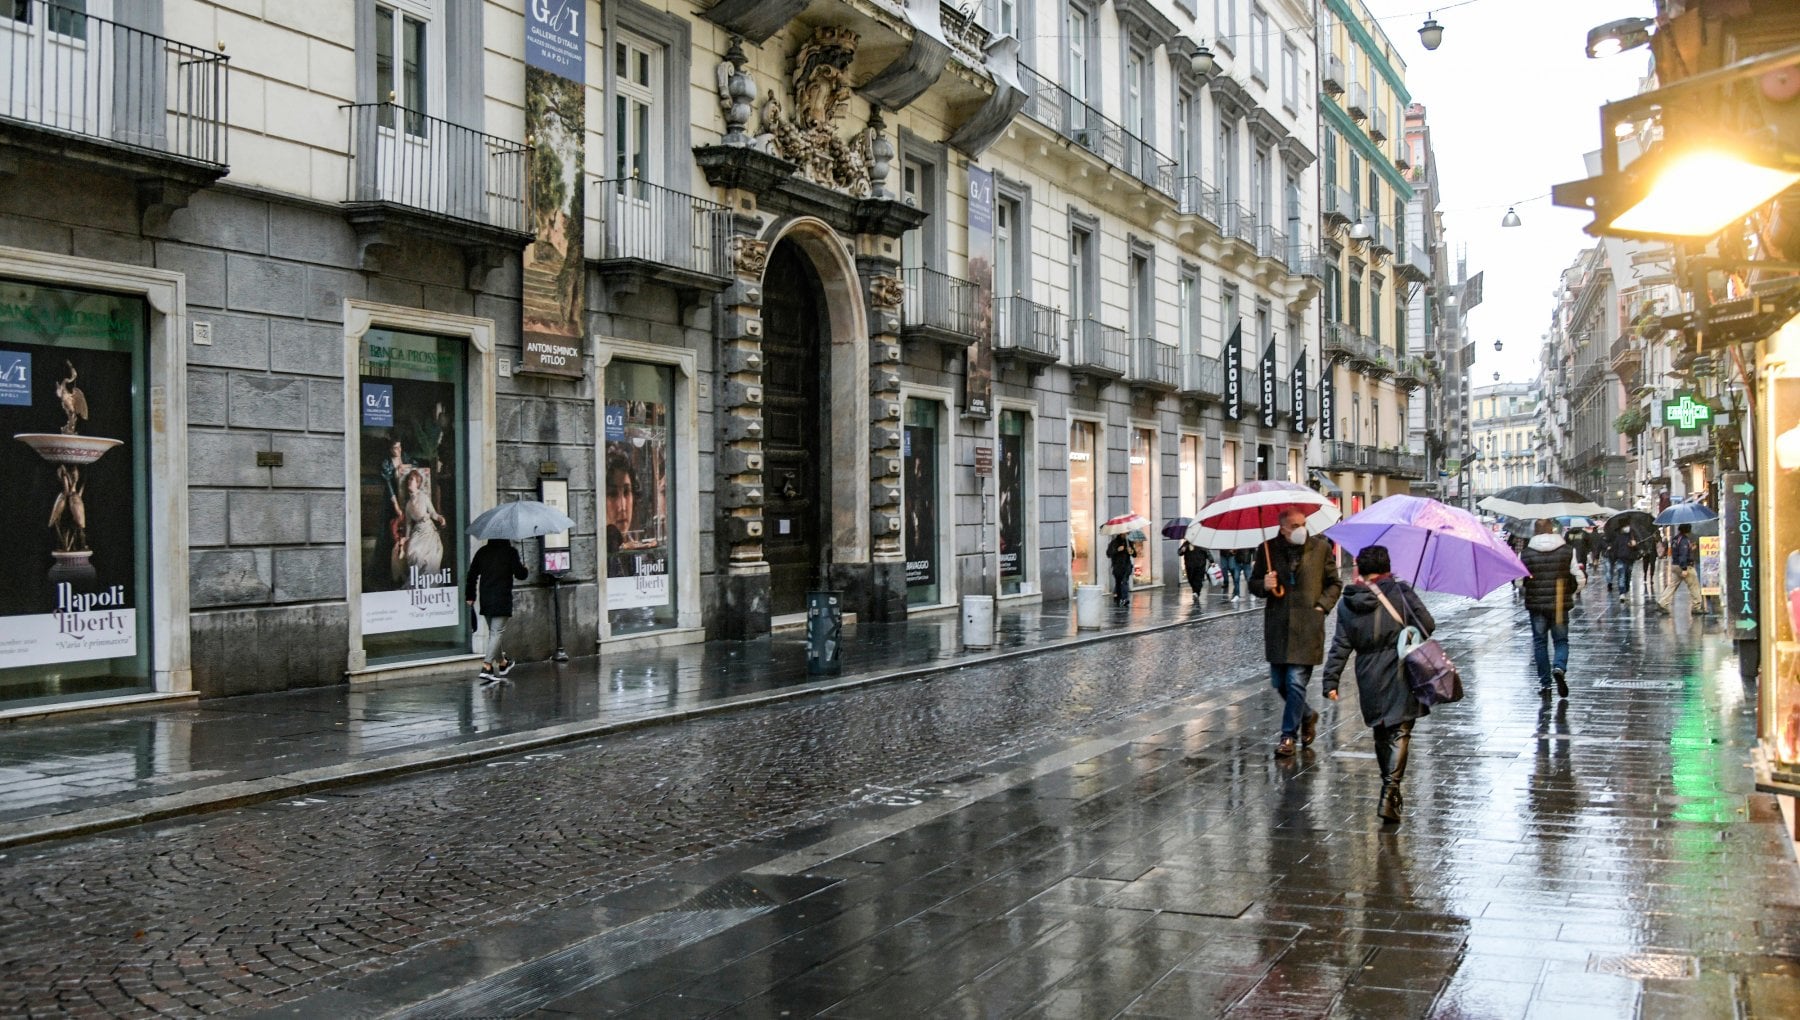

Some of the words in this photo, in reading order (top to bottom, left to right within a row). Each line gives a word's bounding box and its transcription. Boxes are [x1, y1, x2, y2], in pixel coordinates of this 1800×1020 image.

[531, 26, 557, 43] GALLERIE
[557, 36, 579, 51] D'ITALIA
[541, 49, 569, 66] NAPOLI
[527, 342, 552, 354] ANTON
[553, 345, 578, 357] SMINCK
[540, 354, 566, 366] PITLOO
[1228, 344, 1239, 420] ALCOTT
[1263, 358, 1274, 428] ALCOTT
[1294, 368, 1304, 433] ALCOTT
[1322, 378, 1331, 439] ALCOTT
[635, 555, 665, 577] Napoli
[906, 560, 929, 571] RAVAGGIO
[1738, 499, 1754, 615] PROFUMERIA
[409, 565, 452, 590] Napoli
[58, 581, 125, 613] Napoli
[406, 587, 453, 611] Liberty
[52, 608, 128, 640] Liberty
